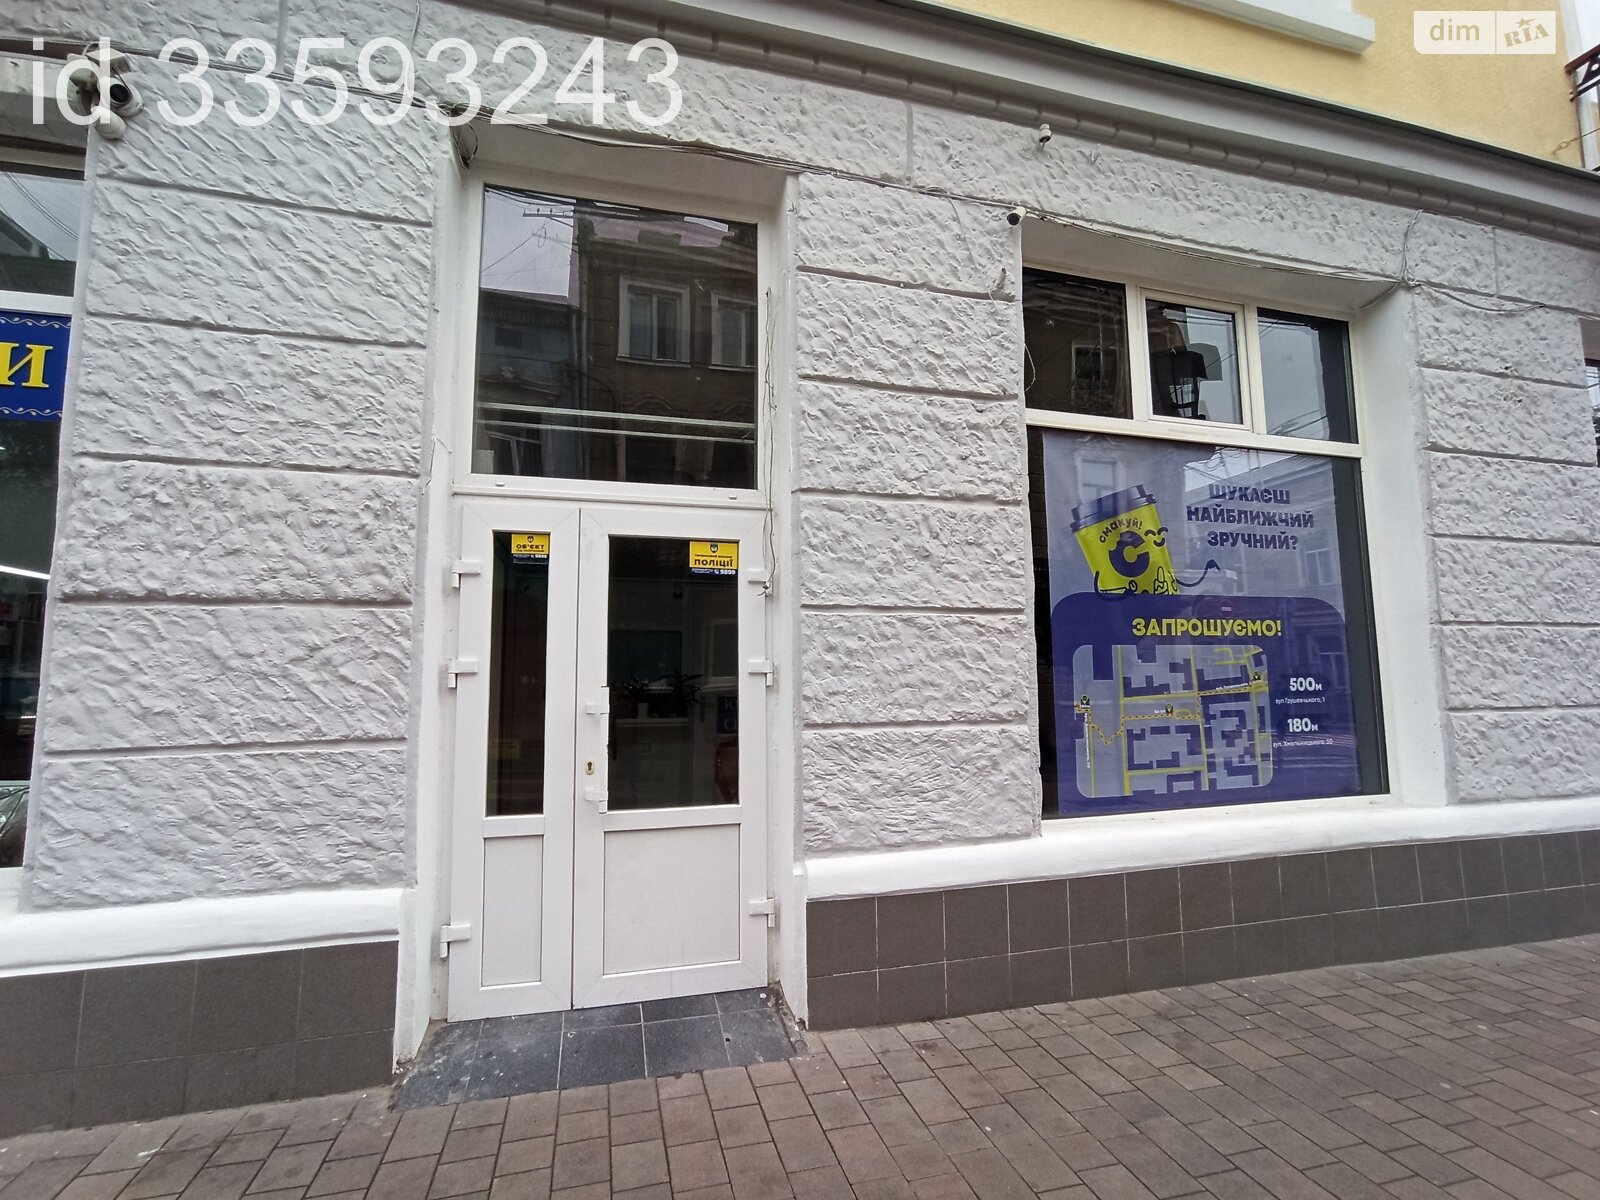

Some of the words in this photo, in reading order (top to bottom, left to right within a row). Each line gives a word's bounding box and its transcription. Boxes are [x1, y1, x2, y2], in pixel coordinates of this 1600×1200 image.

[1208, 484, 1291, 505] ШУКАЄШ
[1186, 504, 1315, 529] НАЙБЛИЖЧИЙ
[1206, 530, 1299, 551] ЗРУЧНИЙ?
[694, 558, 734, 568] ПОЛІЦІЇ
[1131, 617, 1282, 637] ЗАПРОШУЄМО!
[1289, 677, 1322, 692] 500м
[1287, 717, 1319, 733] 180м
